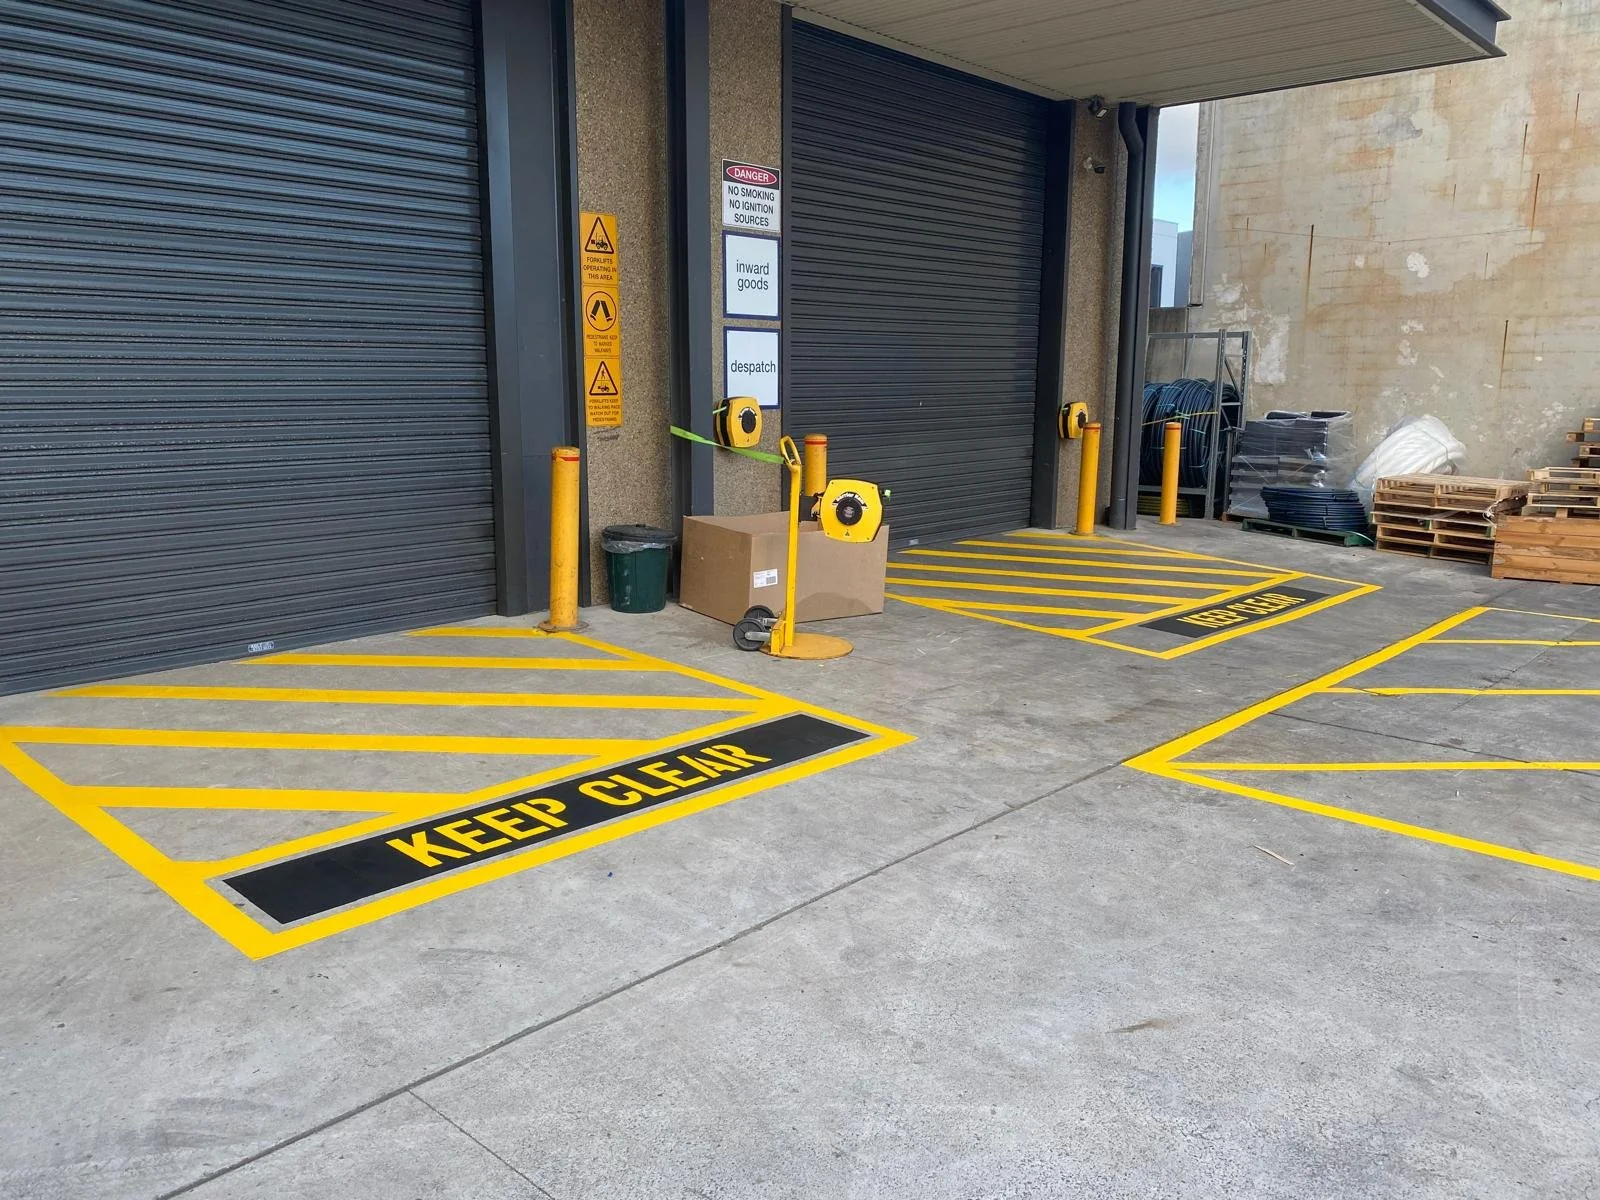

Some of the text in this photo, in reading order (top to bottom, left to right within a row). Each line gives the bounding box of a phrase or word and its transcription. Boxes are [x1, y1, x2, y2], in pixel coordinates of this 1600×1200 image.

[734, 167, 769, 183] DANGER
[728, 185, 775, 201] NO SMOKING
[729, 199, 774, 215] NO IGNITION
[734, 213, 769, 227] SOURCES
[586, 256, 613, 264] FORKLIFTS
[736, 260, 770, 275] inward
[583, 264, 611, 273] OPERATING
[737, 277, 769, 292] goods
[730, 359, 777, 376] despatch
[1176, 592, 1307, 629] KEEP CLEAR
[385, 743, 773, 868] KEEP CLEAR
